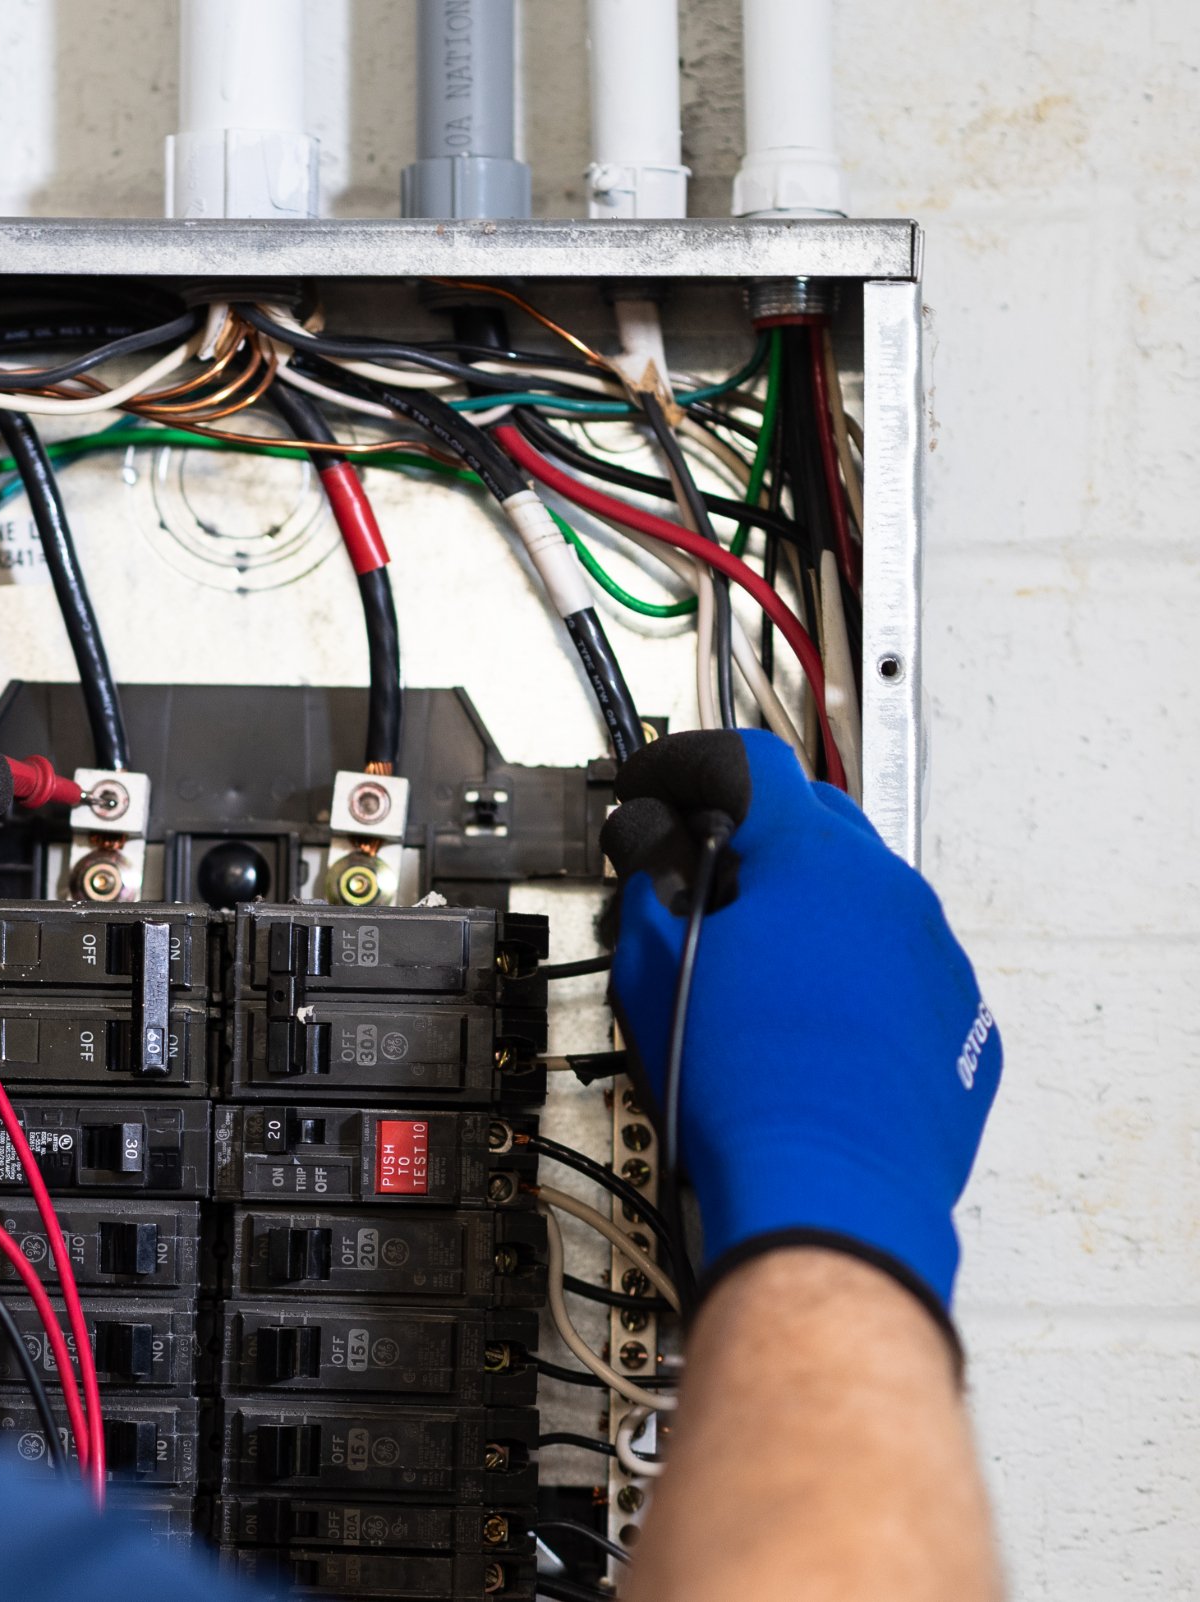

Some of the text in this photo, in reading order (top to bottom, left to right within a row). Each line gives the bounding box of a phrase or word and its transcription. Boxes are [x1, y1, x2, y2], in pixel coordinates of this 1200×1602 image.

[82, 934, 96, 965] OFF
[170, 938, 180, 961] ON
[342, 929, 356, 962] OFF
[361, 929, 377, 965] 30A
[80, 1031, 93, 1062] OFF
[147, 1031, 160, 1054] 60
[342, 1029, 355, 1062] OFF
[360, 1028, 374, 1064] 30A
[268, 1120, 281, 1139] 20
[125, 1139, 137, 1159] 30
[413, 1123, 426, 1187] TEST 10
[272, 1167, 284, 1187] ON
[296, 1167, 307, 1191] TRIP
[315, 1167, 327, 1193] OFF
[382, 1144, 395, 1187] PUSH
[398, 1156, 410, 1175] TO
[72, 1236, 84, 1264] OFF
[158, 1243, 168, 1264] ON
[341, 1236, 355, 1265] OFF
[361, 1231, 376, 1268] 20A
[152, 1340, 163, 1362] ON
[332, 1335, 345, 1364] OFF
[350, 1332, 366, 1368] 15A
[156, 1440, 167, 1461] ON
[332, 1435, 345, 1464] OFF
[350, 1431, 366, 1468] 15A
[247, 1514, 257, 1535] ON
[328, 1510, 339, 1539] OFF
[346, 1513, 358, 1542] 20A
